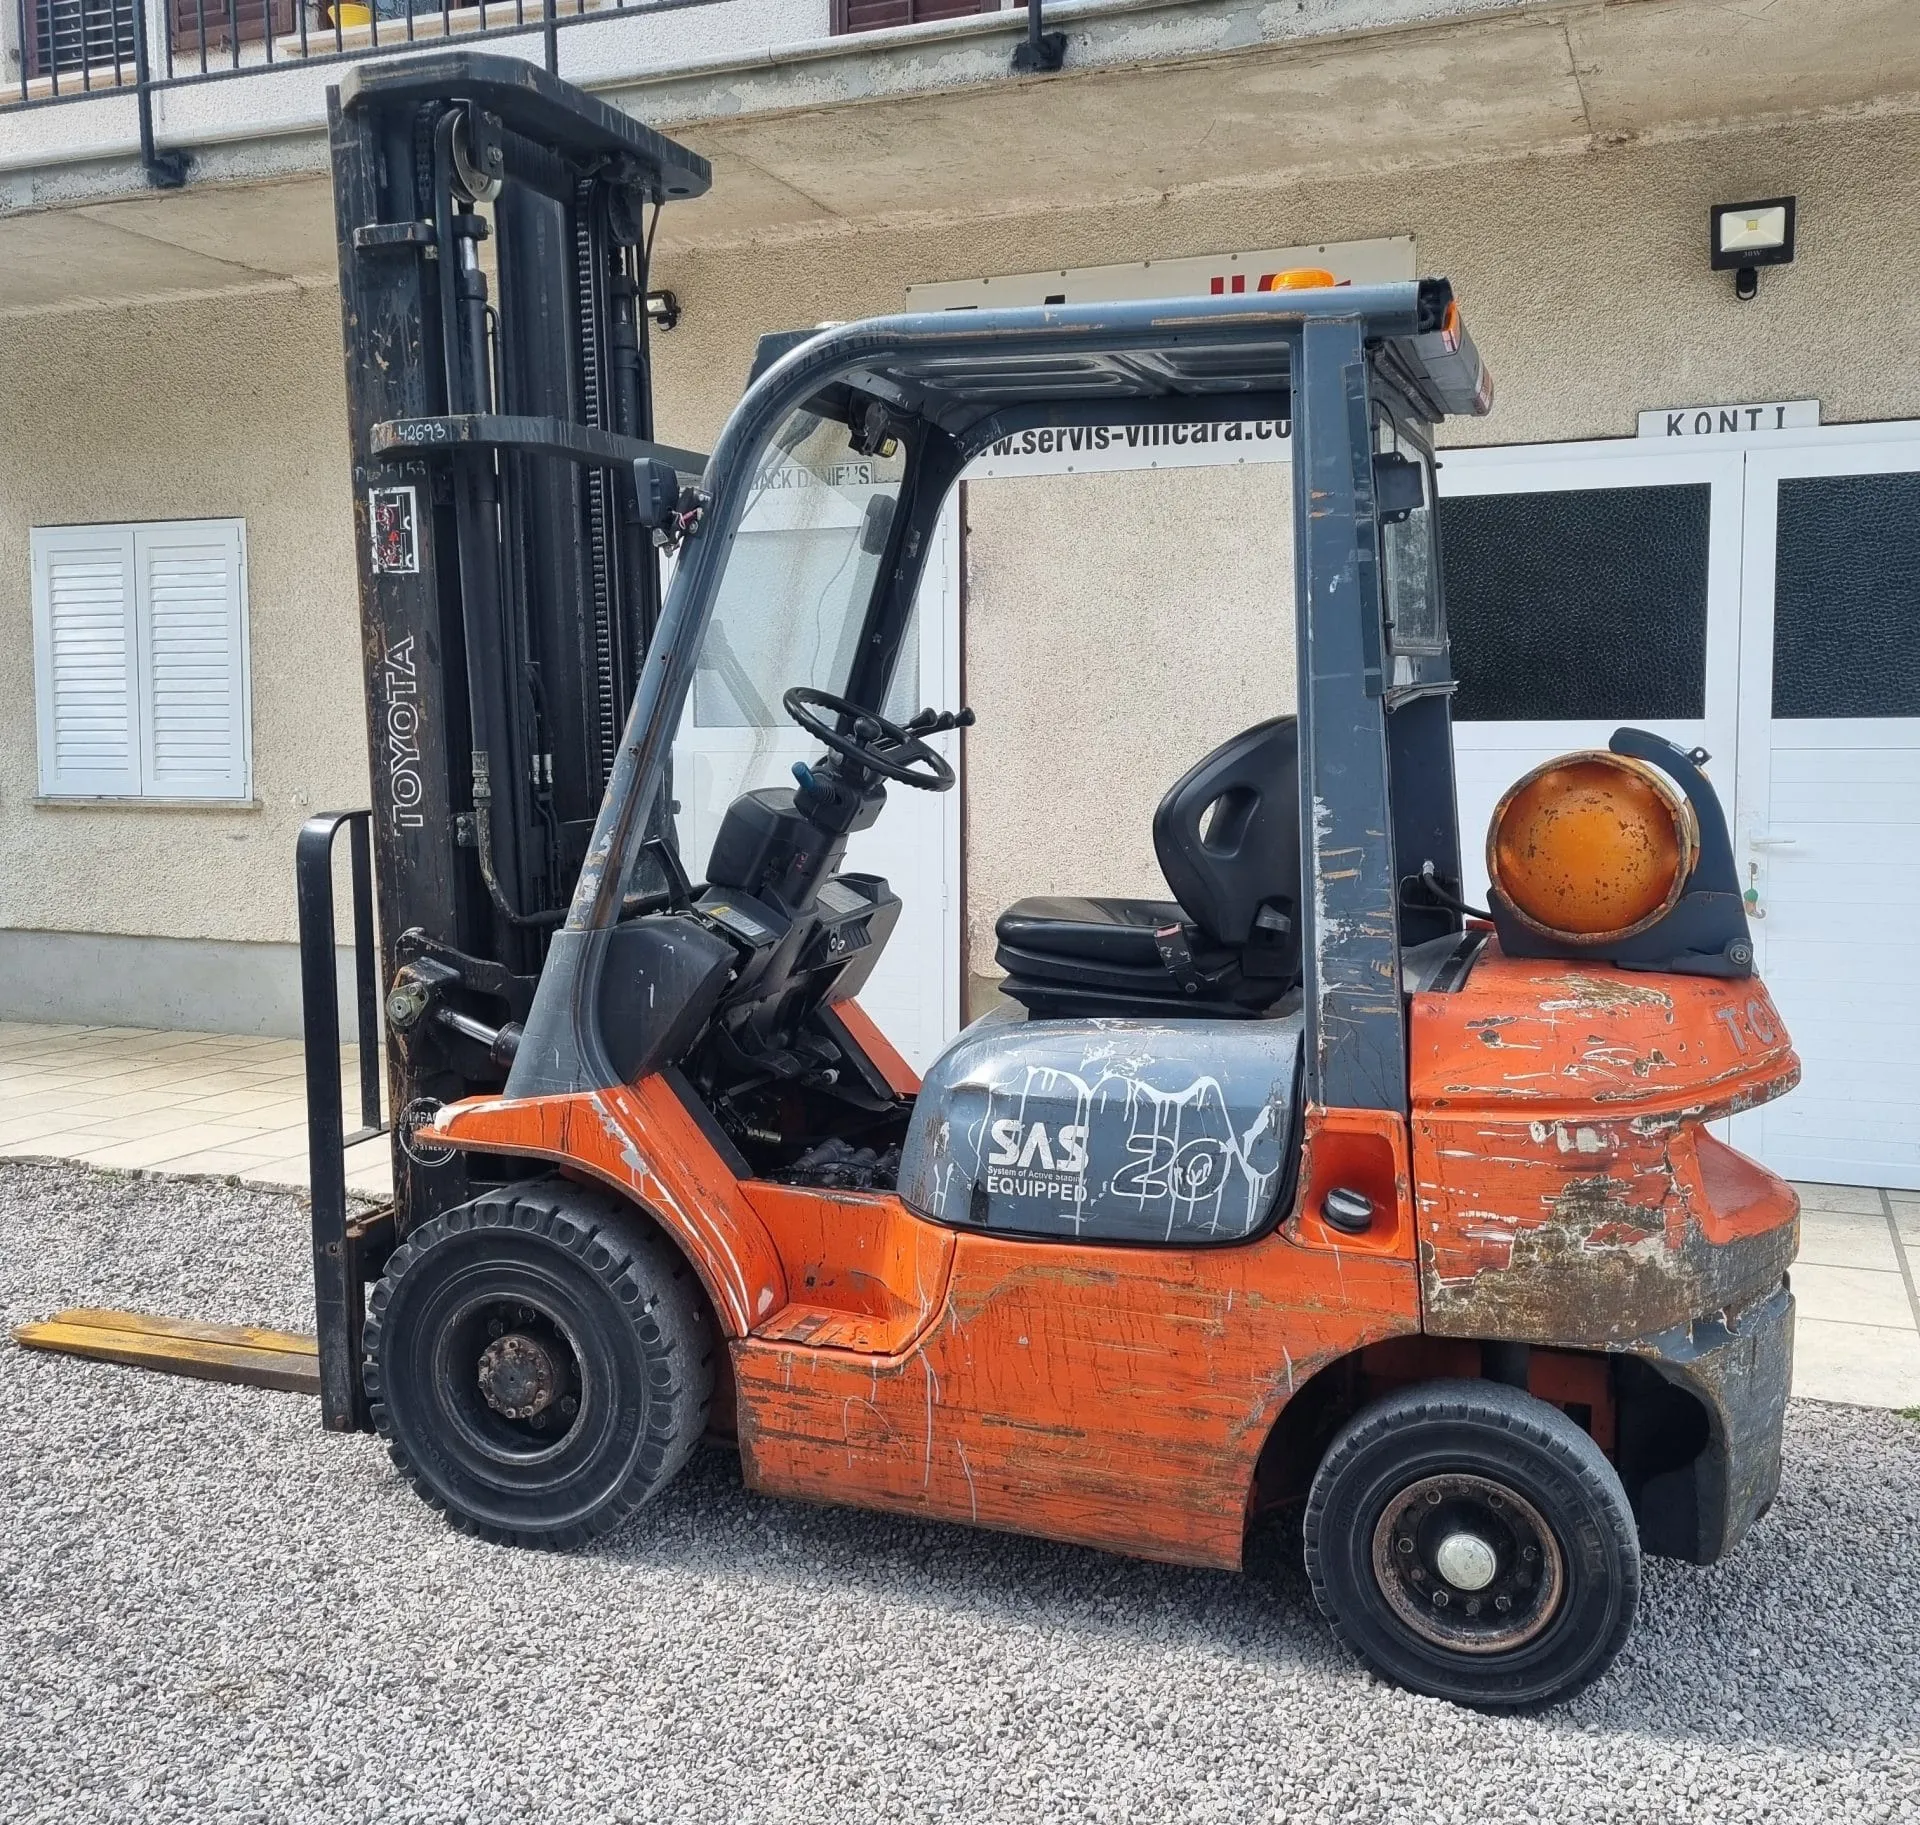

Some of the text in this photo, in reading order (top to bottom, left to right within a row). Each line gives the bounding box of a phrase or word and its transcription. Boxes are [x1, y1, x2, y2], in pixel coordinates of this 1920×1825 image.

[398, 422, 446, 442] 42693
[1666, 405, 1786, 437] KONTI
[385, 633, 424, 837] TOYOTA
[988, 1119, 1090, 1173] SAS
[987, 1165, 1017, 1177] System
[1018, 1168, 1027, 1178] of
[1110, 1134, 1231, 1202] 20
[986, 1175, 1089, 1203] EQUIPPED
